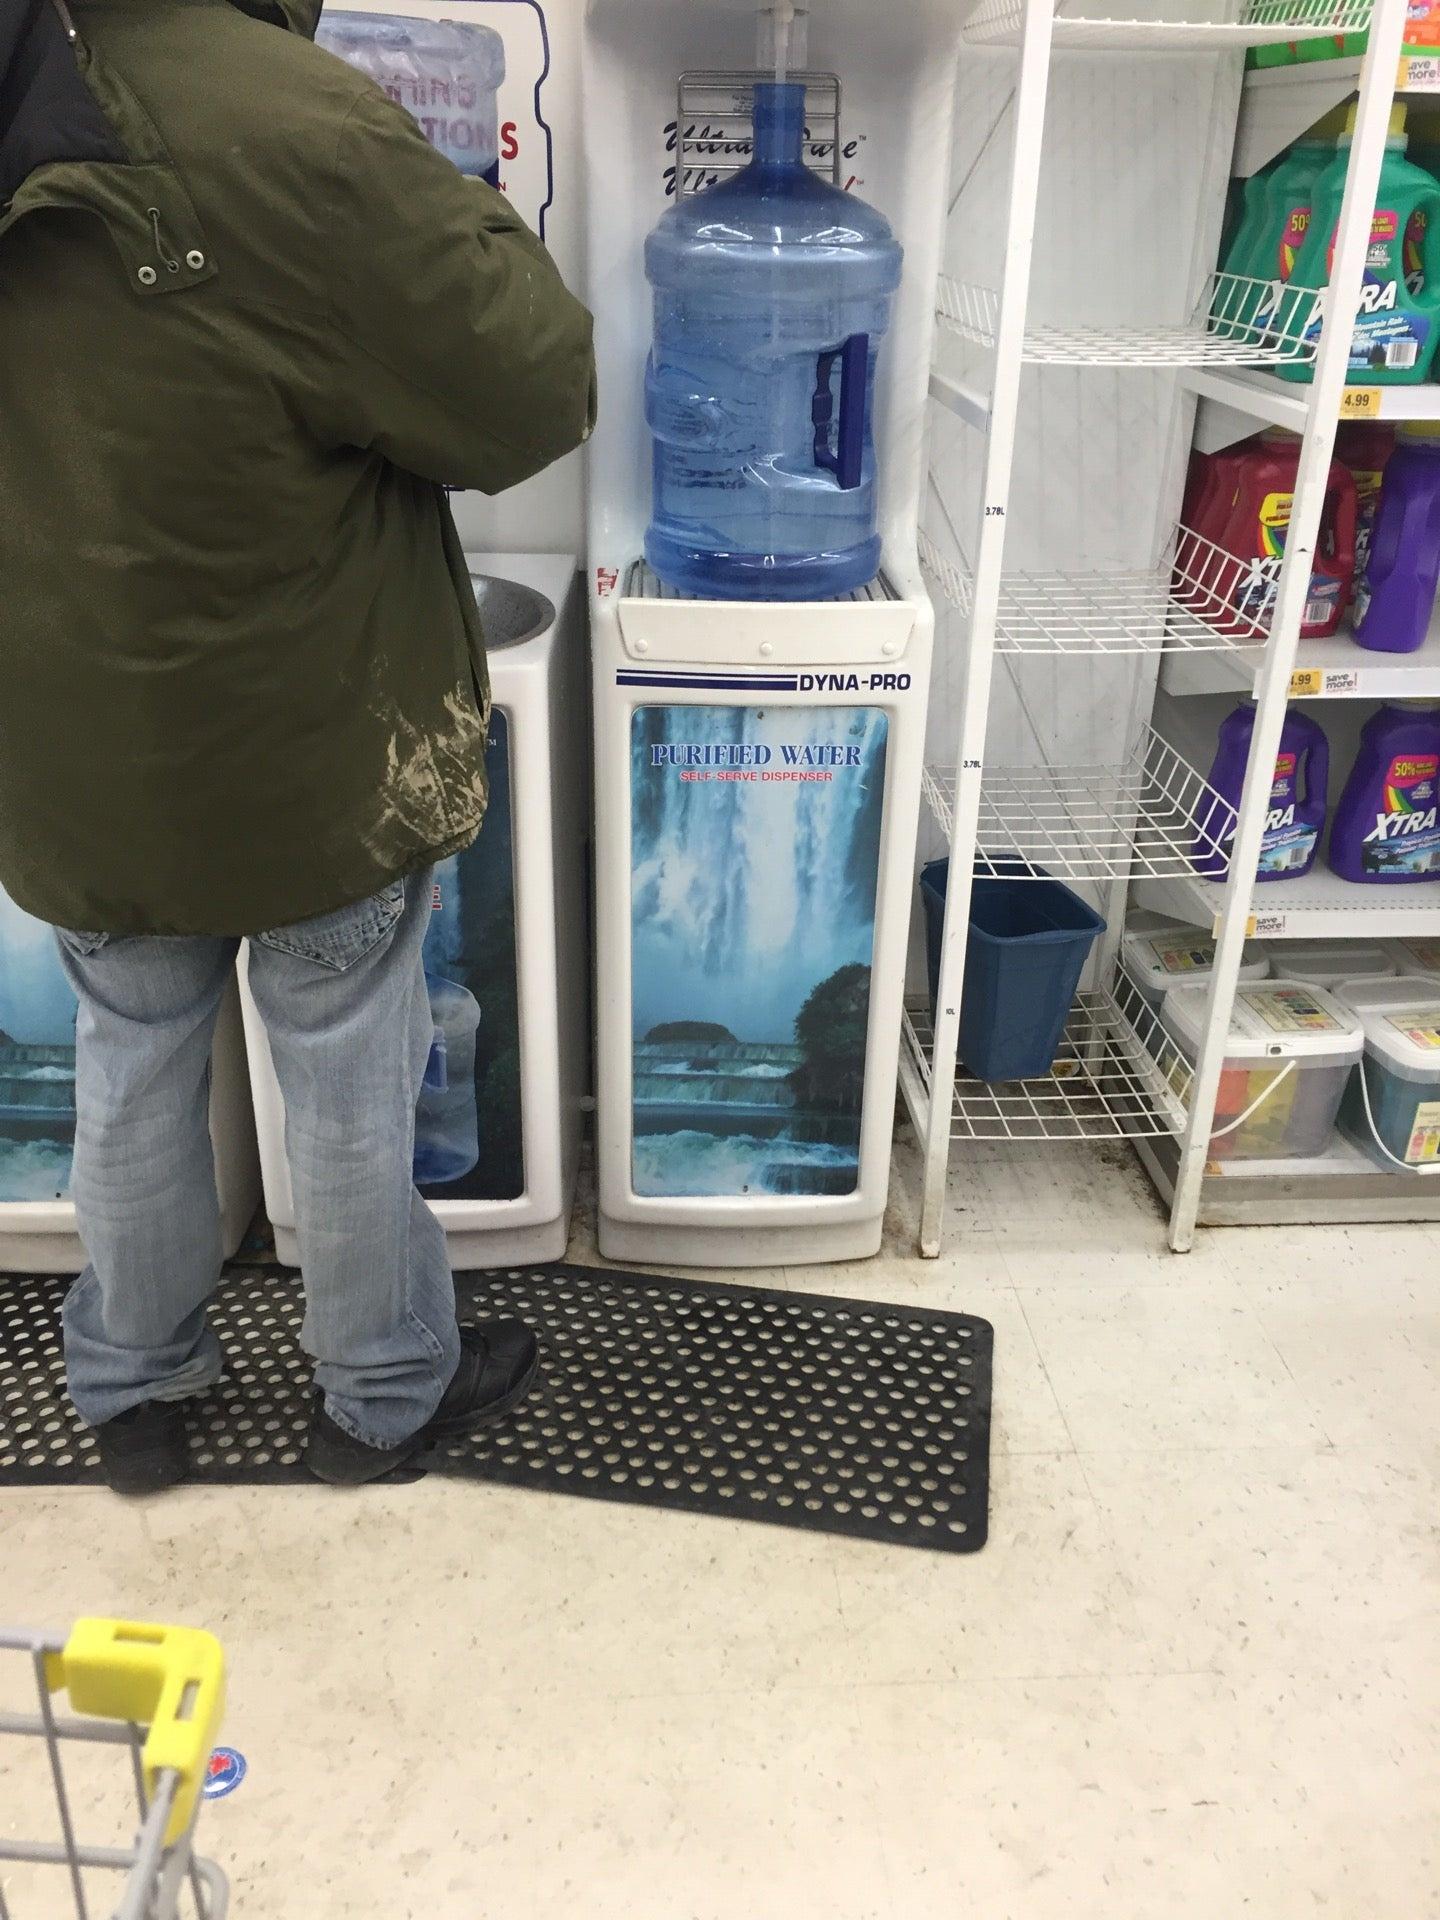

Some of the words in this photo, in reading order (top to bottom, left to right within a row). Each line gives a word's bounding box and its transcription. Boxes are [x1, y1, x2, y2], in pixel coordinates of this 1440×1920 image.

[1408, 60, 1431, 70] ave
[1344, 394, 1370, 406] 4.99
[985, 506, 1005, 516] 3.78L
[800, 673, 911, 691] DYNA-PRO
[1326, 673, 1349, 682] save
[1326, 680, 1354, 689] more
[651, 744, 772, 766] PURIFIED
[780, 743, 861, 766] WATER
[1394, 762, 1415, 776] 50%
[680, 771, 757, 781] SELF-SERVE
[761, 771, 833, 781] DISPENSER
[1363, 807, 1436, 842] XTRA
[1256, 917, 1278, 925] save
